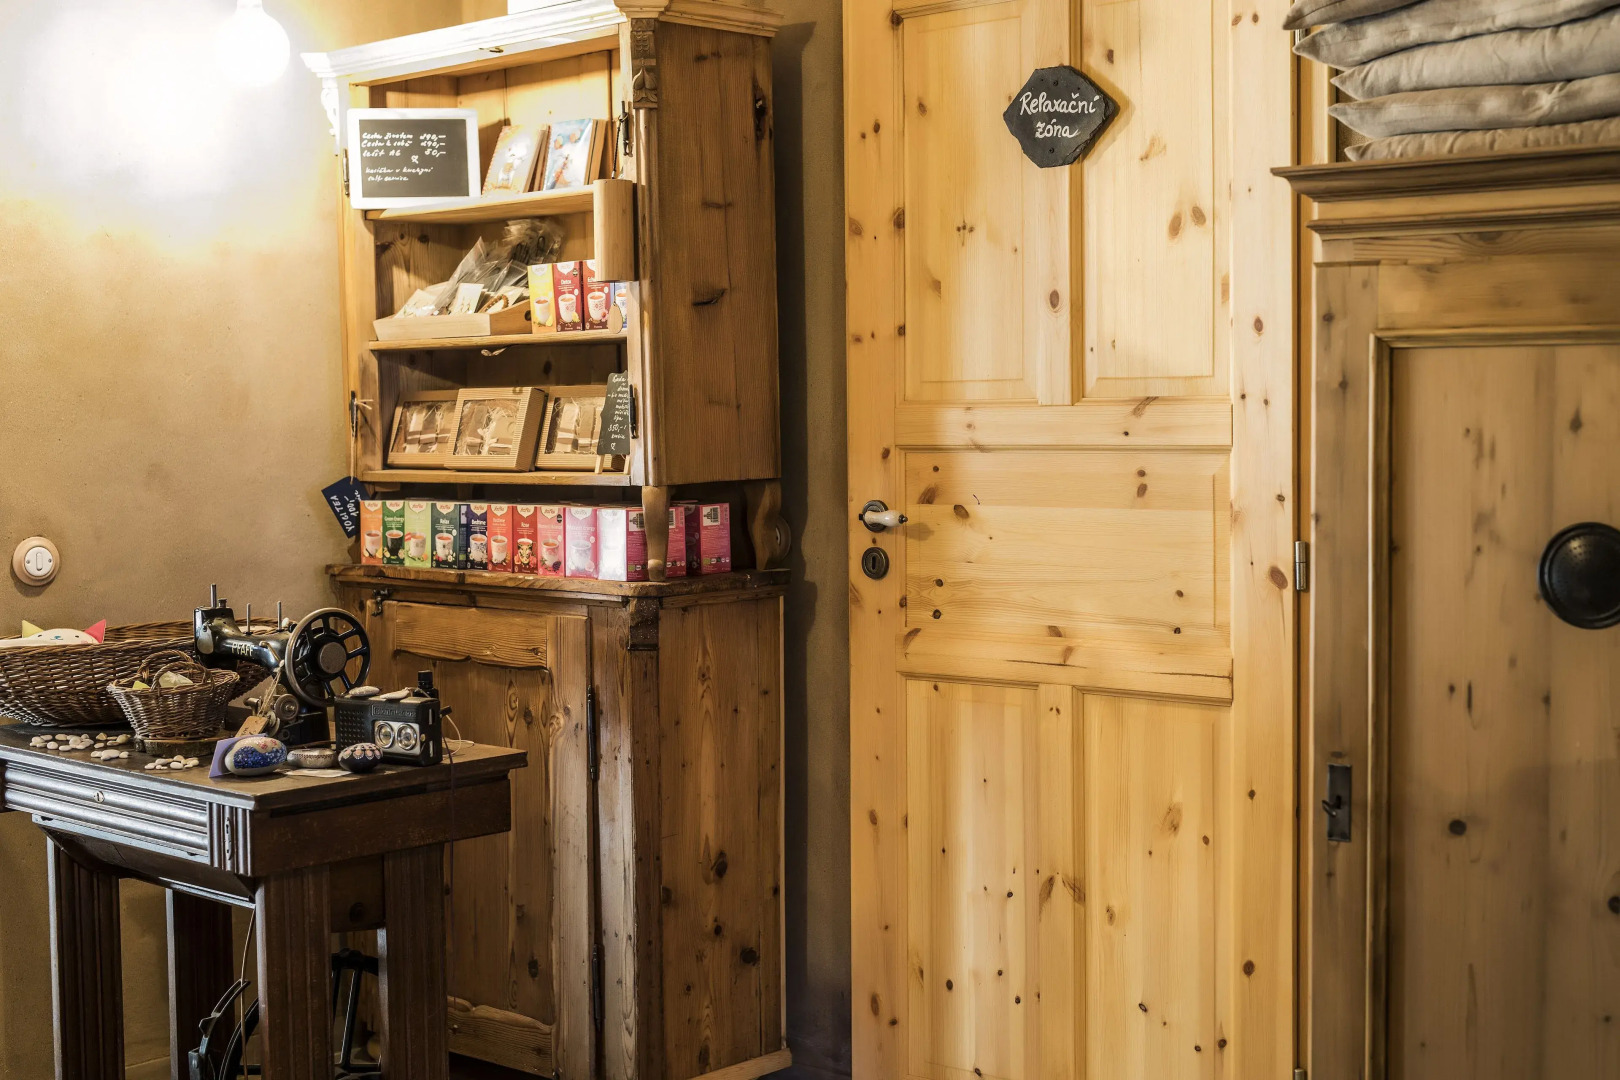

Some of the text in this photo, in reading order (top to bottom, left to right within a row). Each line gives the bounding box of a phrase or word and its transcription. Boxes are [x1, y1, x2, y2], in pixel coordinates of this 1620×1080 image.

[1019, 91, 1099, 115] Relaxační
[1035, 119, 1079, 138] zóna
[330, 495, 355, 532] YOGI TEA
[231, 642, 254, 656] PFAFF
